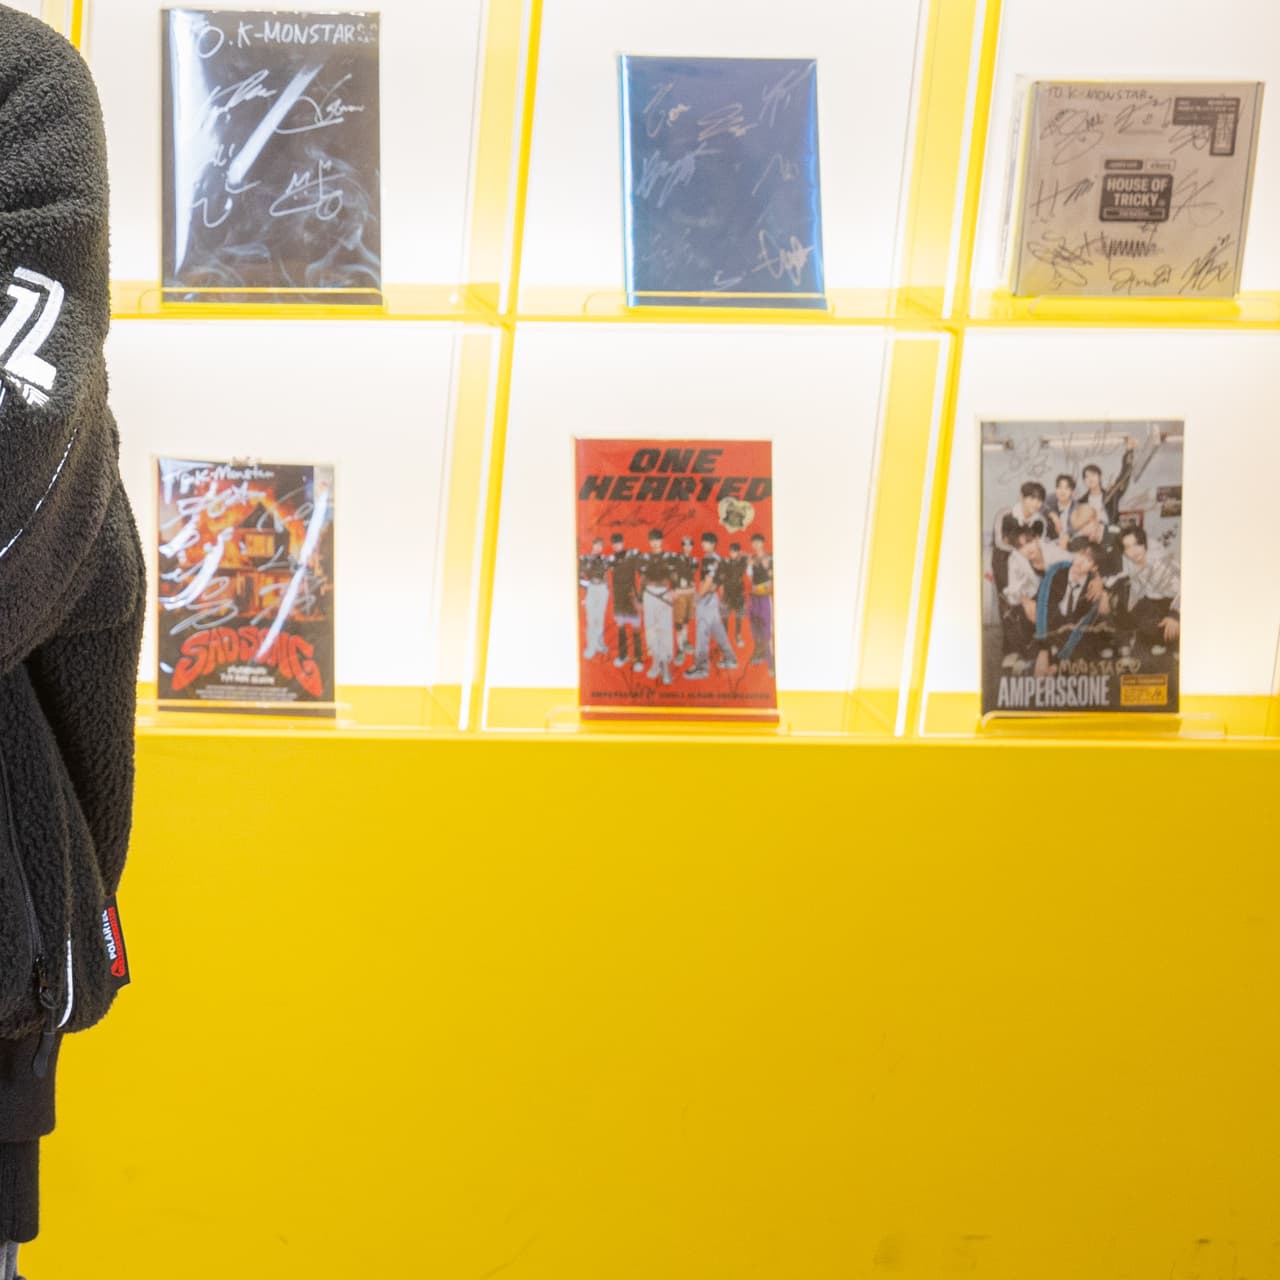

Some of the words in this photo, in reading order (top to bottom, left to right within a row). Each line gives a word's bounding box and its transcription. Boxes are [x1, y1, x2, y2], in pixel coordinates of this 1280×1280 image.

[1107, 177, 1149, 192] HOUSE
[1151, 177, 1169, 192] OF
[1113, 193, 1160, 209] TRICKY
[628, 448, 724, 474] ONE
[579, 475, 773, 502] HEARTED
[997, 675, 1110, 708] AMPERS&ONE
